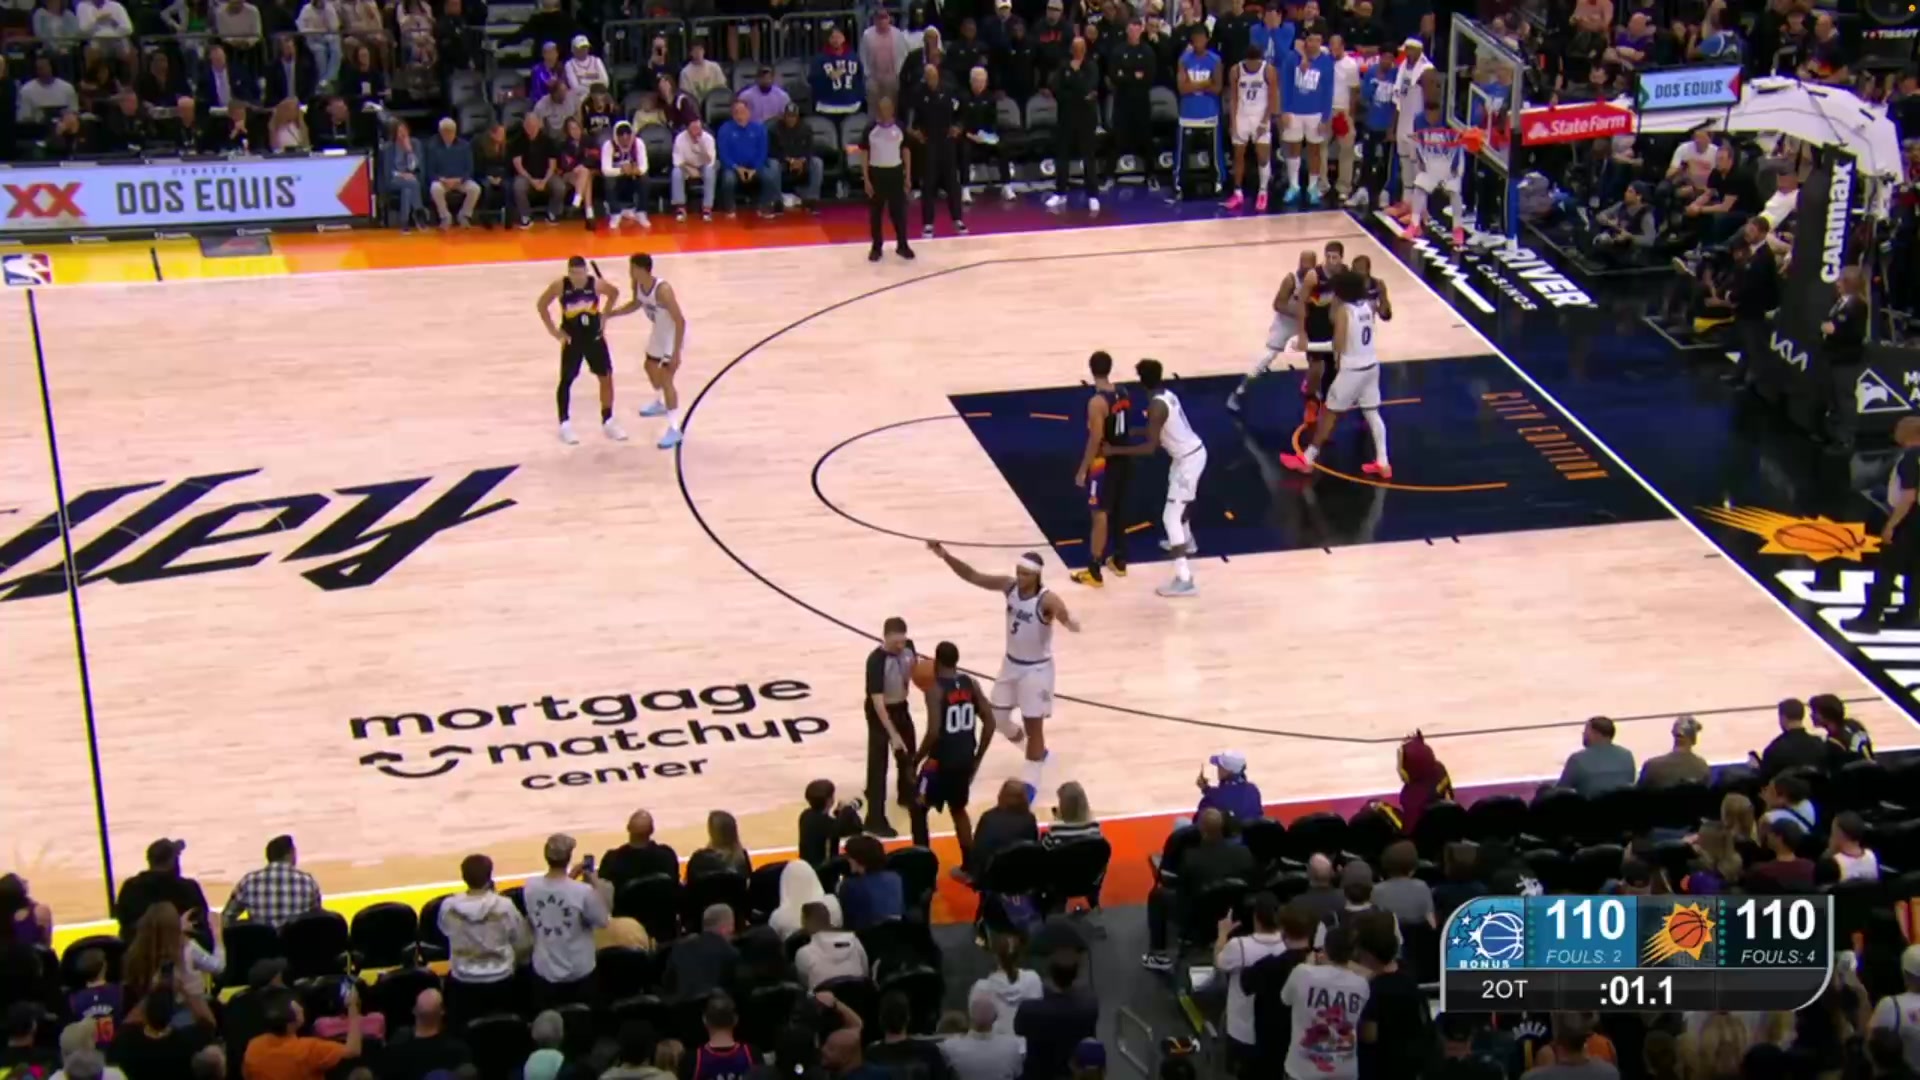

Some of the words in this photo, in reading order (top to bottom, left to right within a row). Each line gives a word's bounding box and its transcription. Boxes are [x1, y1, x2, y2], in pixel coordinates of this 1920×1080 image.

[1655, 82, 1681, 99] DOS
[2, 182, 87, 218] XX
[116, 180, 184, 215] DOS
[194, 176, 296, 213] EQUIS
[1476, 263, 1538, 310] CASINOS
[1492, 247, 1593, 308] RIVER
[1361, 325, 1371, 346] 0
[349, 679, 812, 740] mortgage
[945, 702, 975, 734] 00
[486, 715, 830, 764] matchup
[521, 757, 709, 790] center
